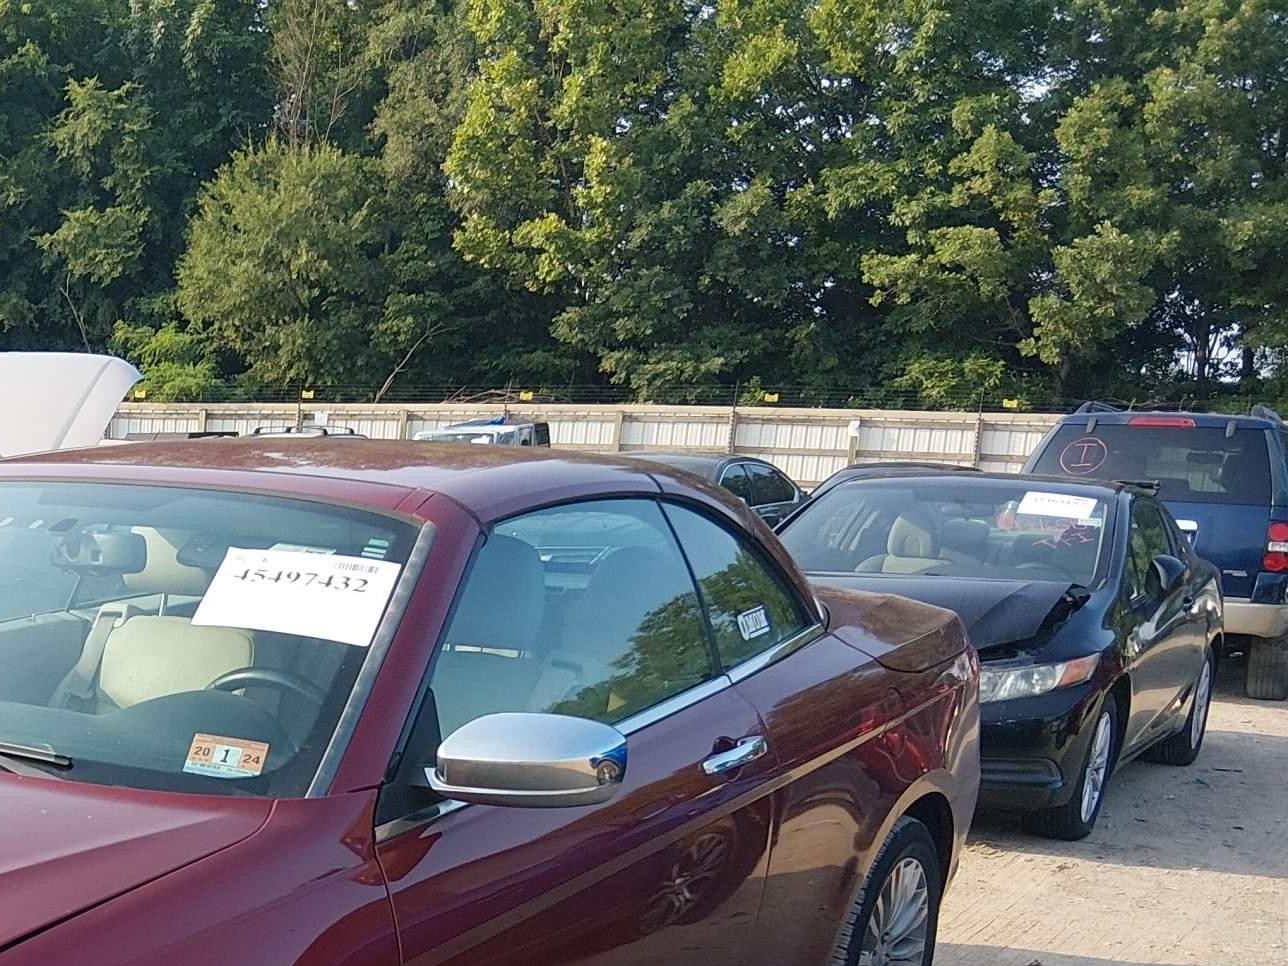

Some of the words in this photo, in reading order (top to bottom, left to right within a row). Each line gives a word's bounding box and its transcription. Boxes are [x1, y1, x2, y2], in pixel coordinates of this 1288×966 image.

[234, 568, 369, 593] 45497432
[193, 746, 210, 757] 20
[219, 748, 231, 763] 1
[242, 753, 260, 765] 24
